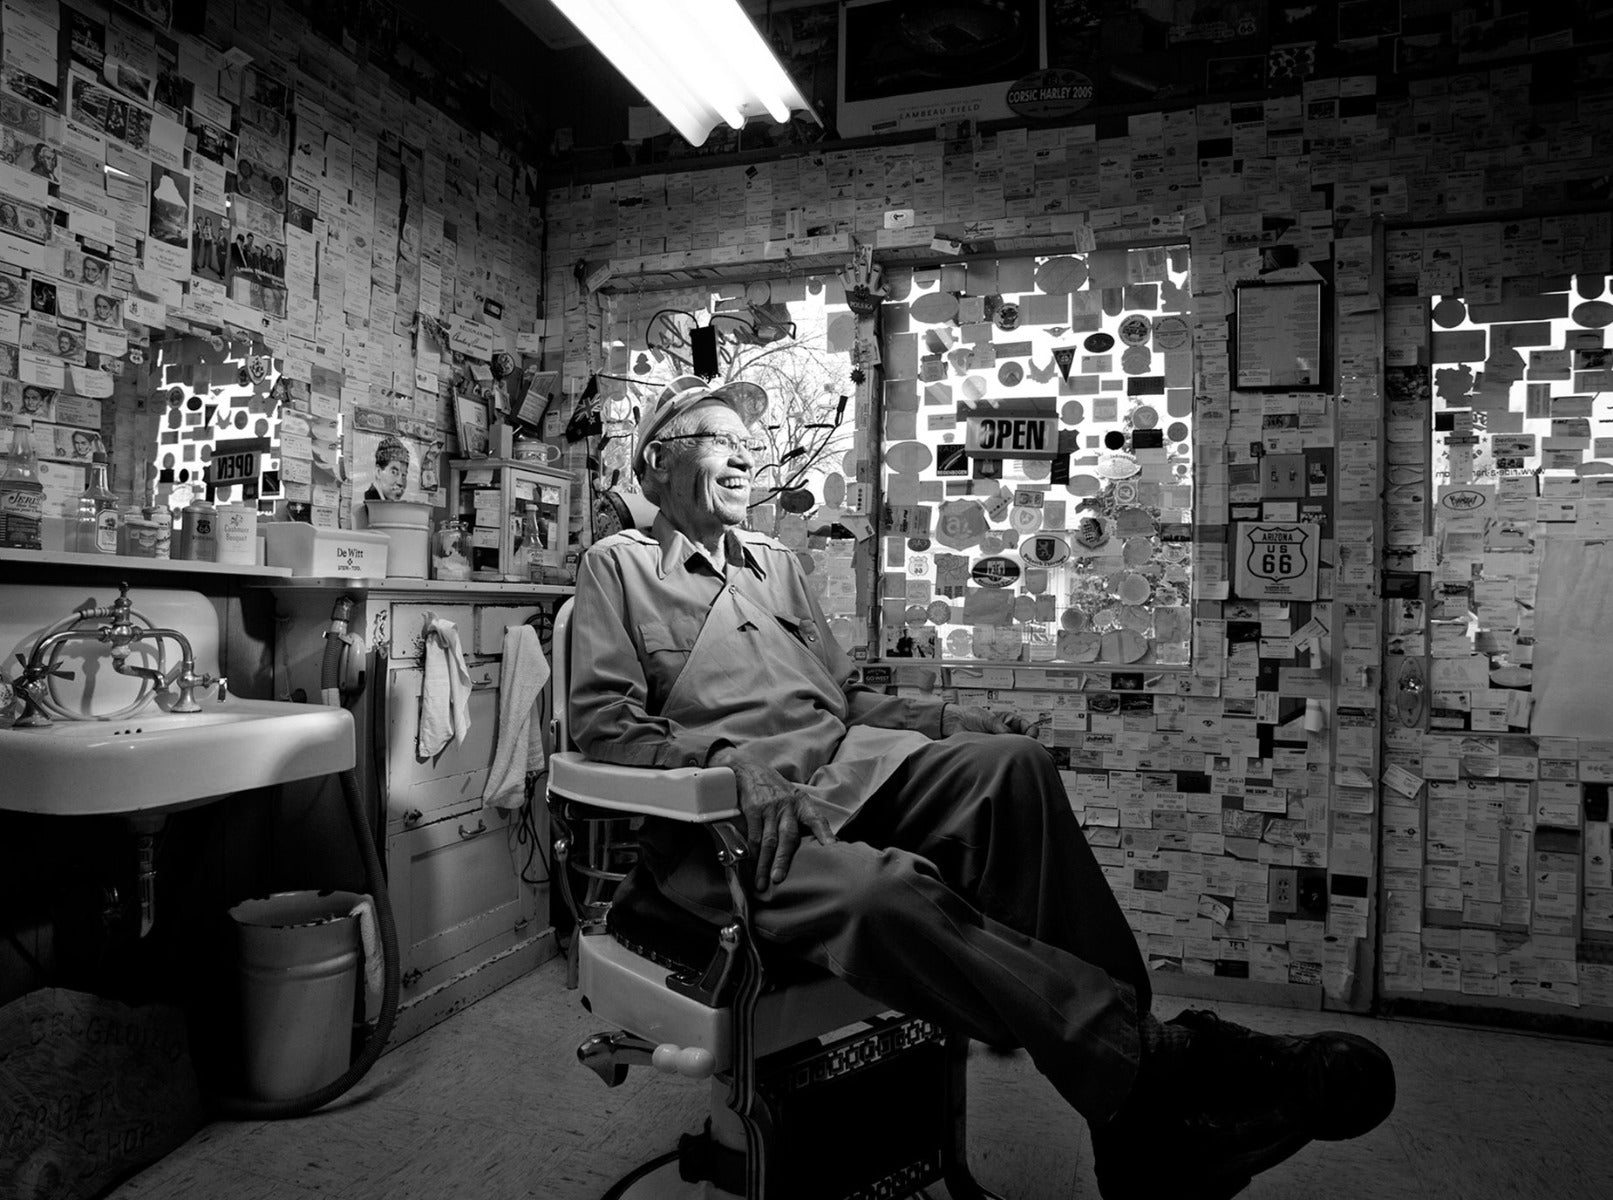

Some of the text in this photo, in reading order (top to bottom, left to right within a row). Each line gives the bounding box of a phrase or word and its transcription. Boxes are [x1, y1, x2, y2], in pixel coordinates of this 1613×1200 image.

[1008, 89, 1038, 104] CORSIC
[1039, 86, 1071, 100] HARLEY
[899, 108, 946, 120] LAMBEAU
[950, 102, 980, 113] FIELD
[979, 419, 1045, 450] OPEN
[8, 491, 41, 505] JERIS
[1262, 532, 1293, 541] ARIZONA
[337, 547, 364, 558] De Witt
[1262, 553, 1292, 574] 66
